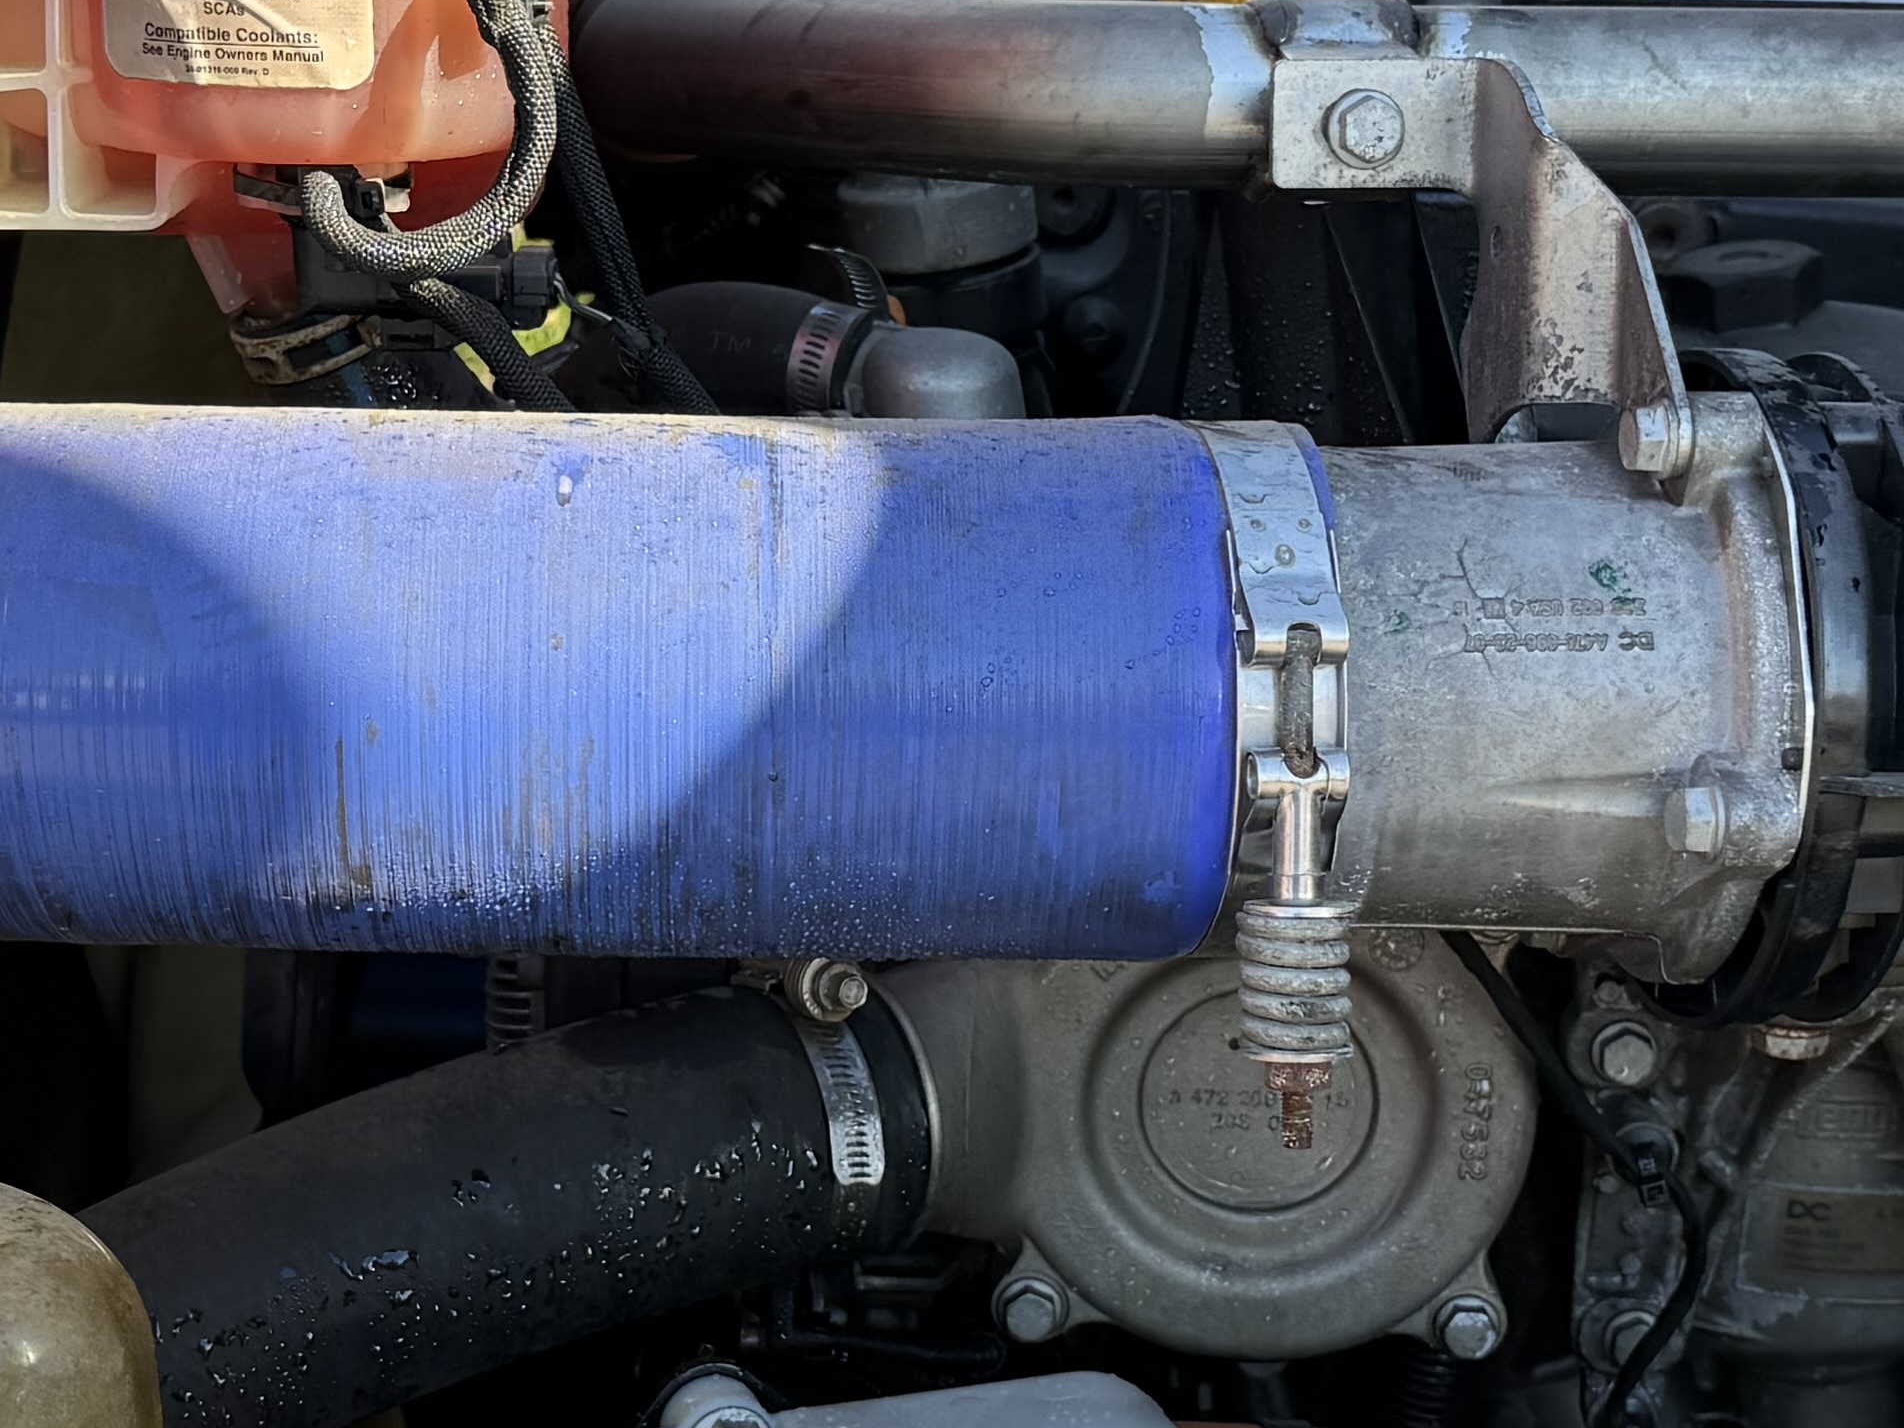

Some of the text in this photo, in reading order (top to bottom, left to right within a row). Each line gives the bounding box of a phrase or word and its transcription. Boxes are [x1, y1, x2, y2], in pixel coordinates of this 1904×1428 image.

[203, 1, 246, 17] SCAs
[145, 23, 318, 46] Compatible Coolants:
[143, 43, 325, 64] See Engine Owners Manual
[1618, 630, 1656, 651] DC
[1194, 1090, 1230, 1107] 472
[1786, 1198, 1832, 1223] DC
